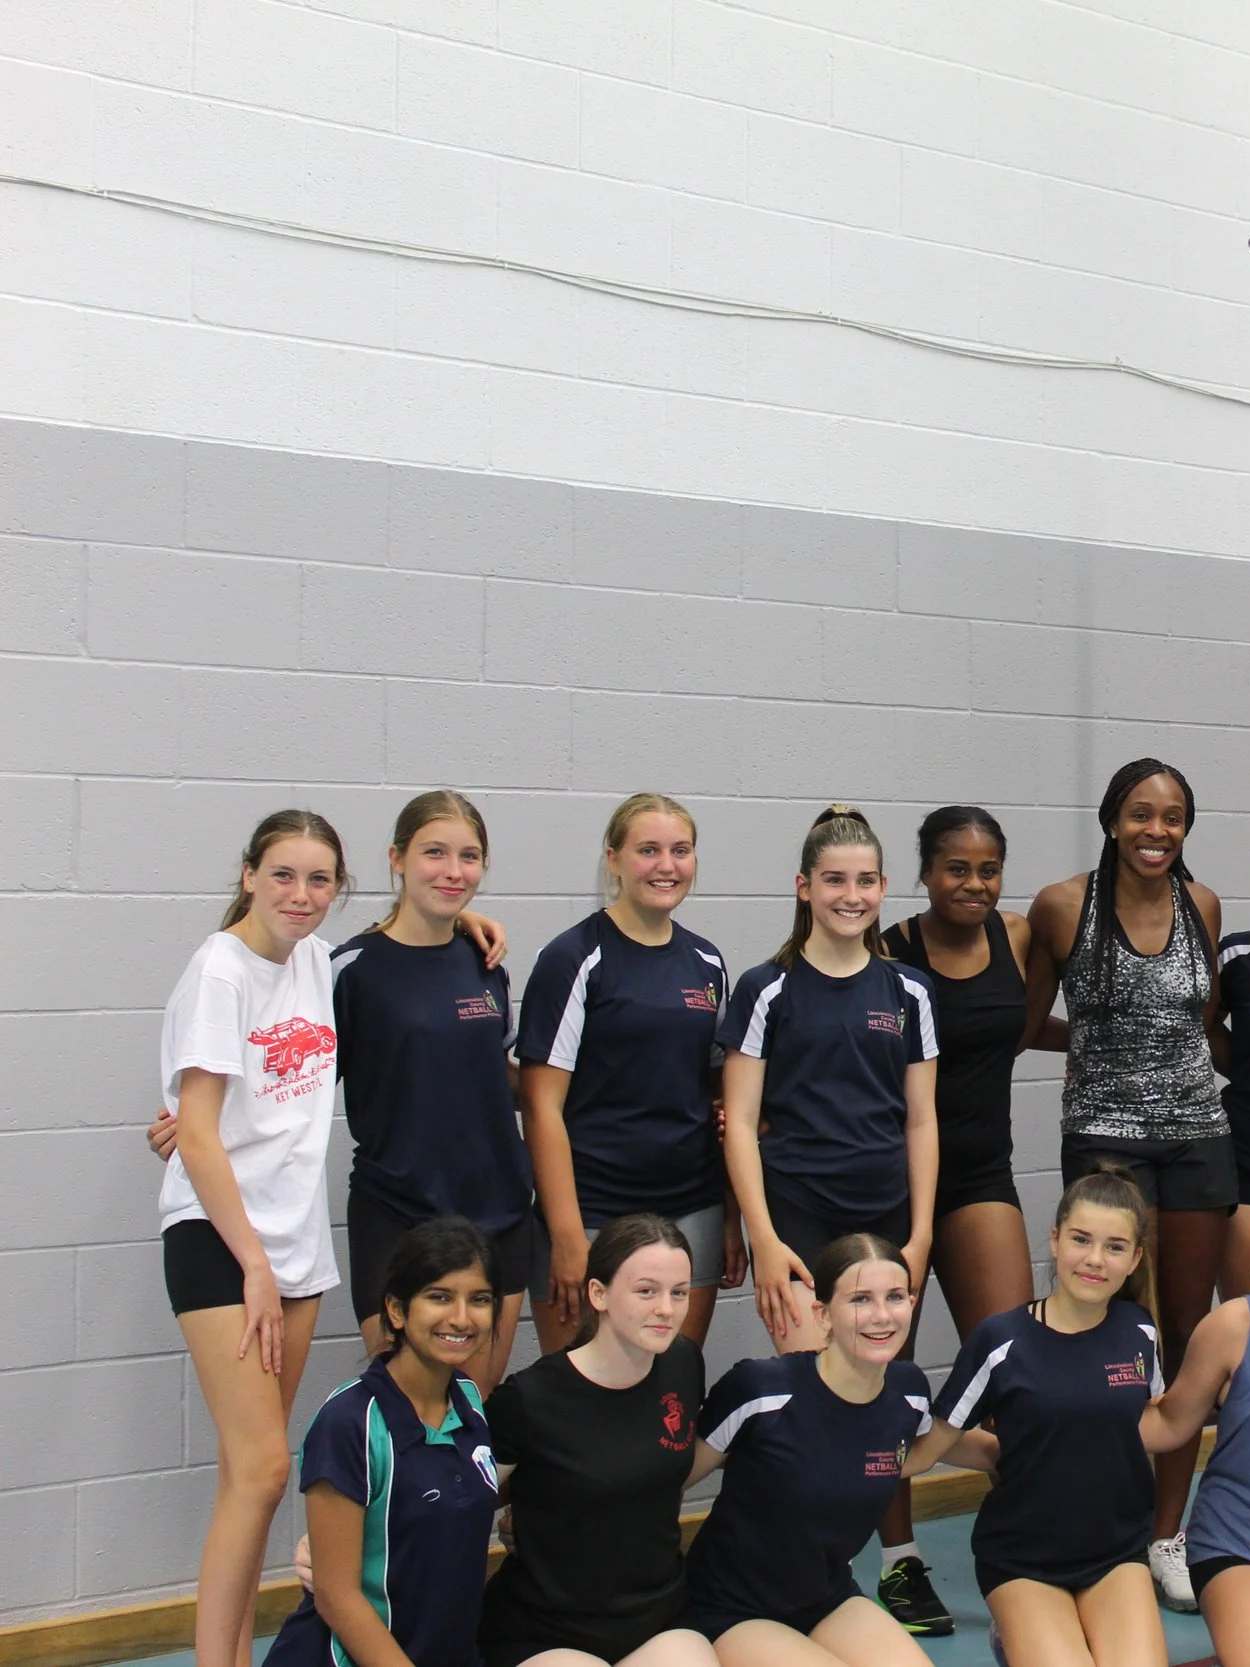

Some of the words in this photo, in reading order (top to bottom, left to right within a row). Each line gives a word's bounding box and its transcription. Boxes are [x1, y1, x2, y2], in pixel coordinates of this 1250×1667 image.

[458, 1006, 493, 1015] NETBALL
[868, 1019, 899, 1031] NETBALL
[275, 1089, 291, 1104] KEY
[291, 1079, 316, 1098] WEST
[1108, 1373, 1140, 1382] NETBALL
[865, 1462, 897, 1471] NETBALL
